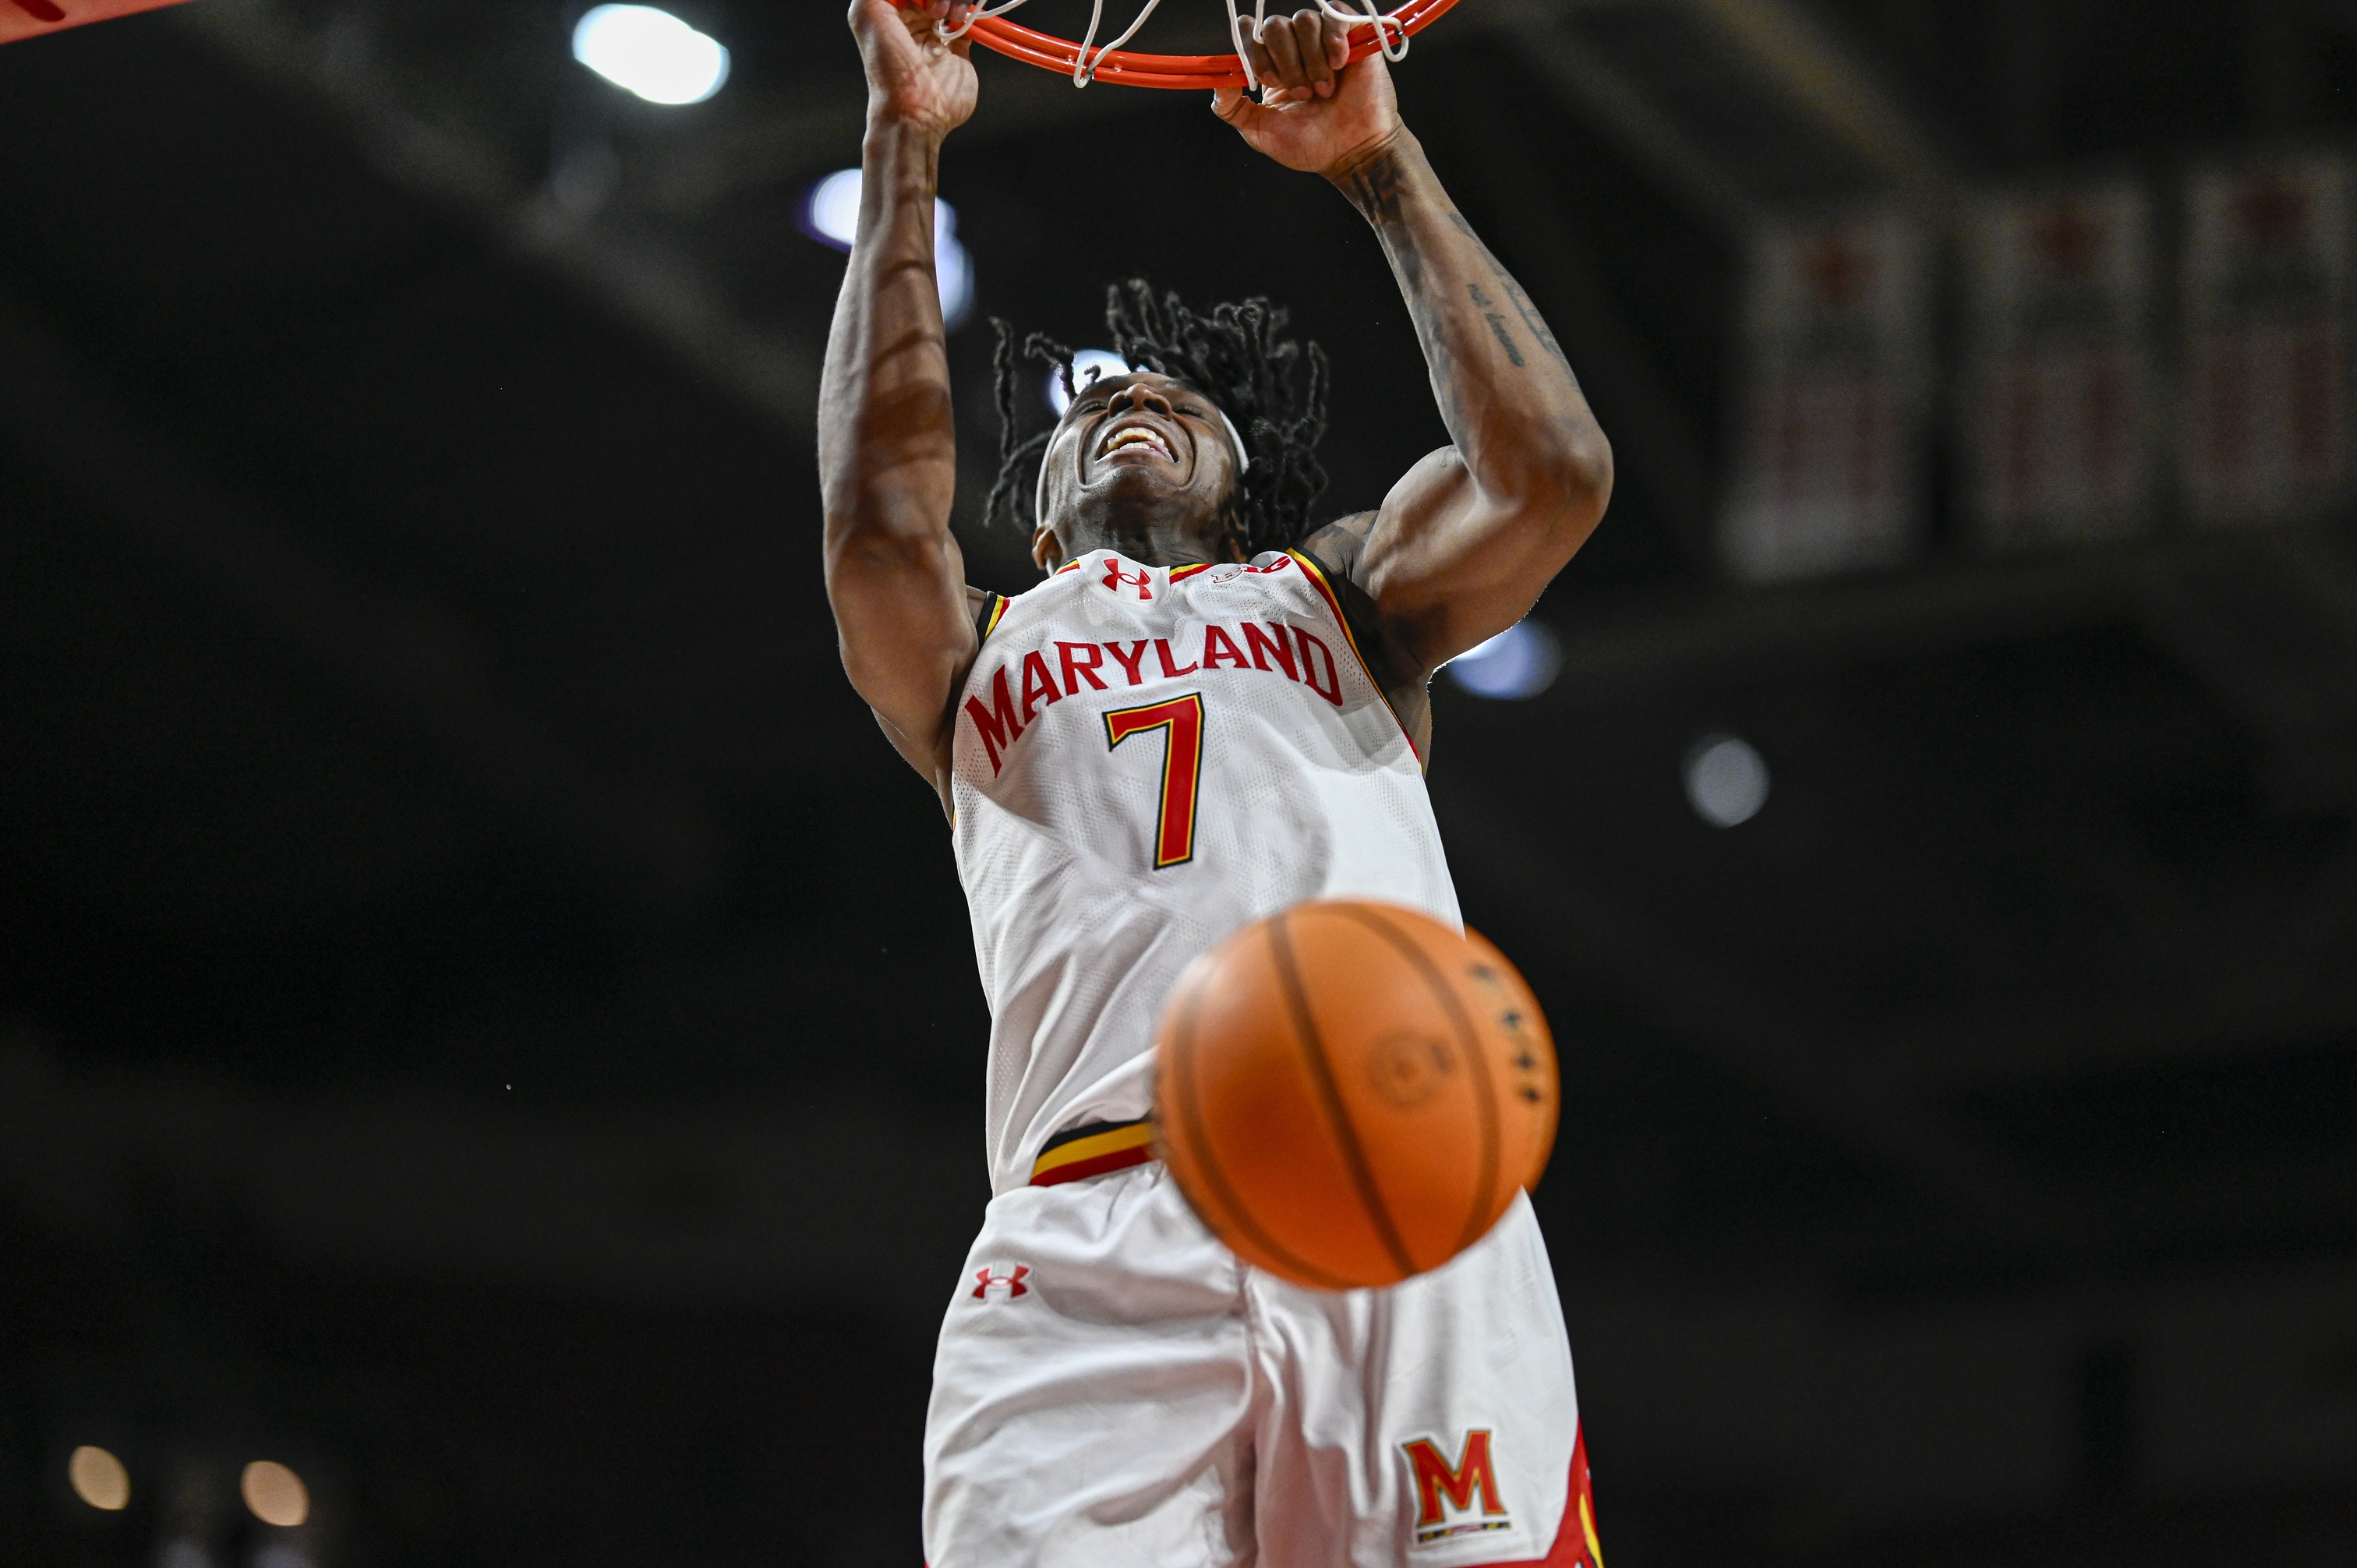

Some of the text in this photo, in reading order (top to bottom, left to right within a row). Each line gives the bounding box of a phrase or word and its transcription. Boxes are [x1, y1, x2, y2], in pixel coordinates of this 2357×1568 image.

[964, 621, 1343, 778] MARYLAND
[1102, 692, 1205, 871] 7
[1402, 1429, 1507, 1528] M
